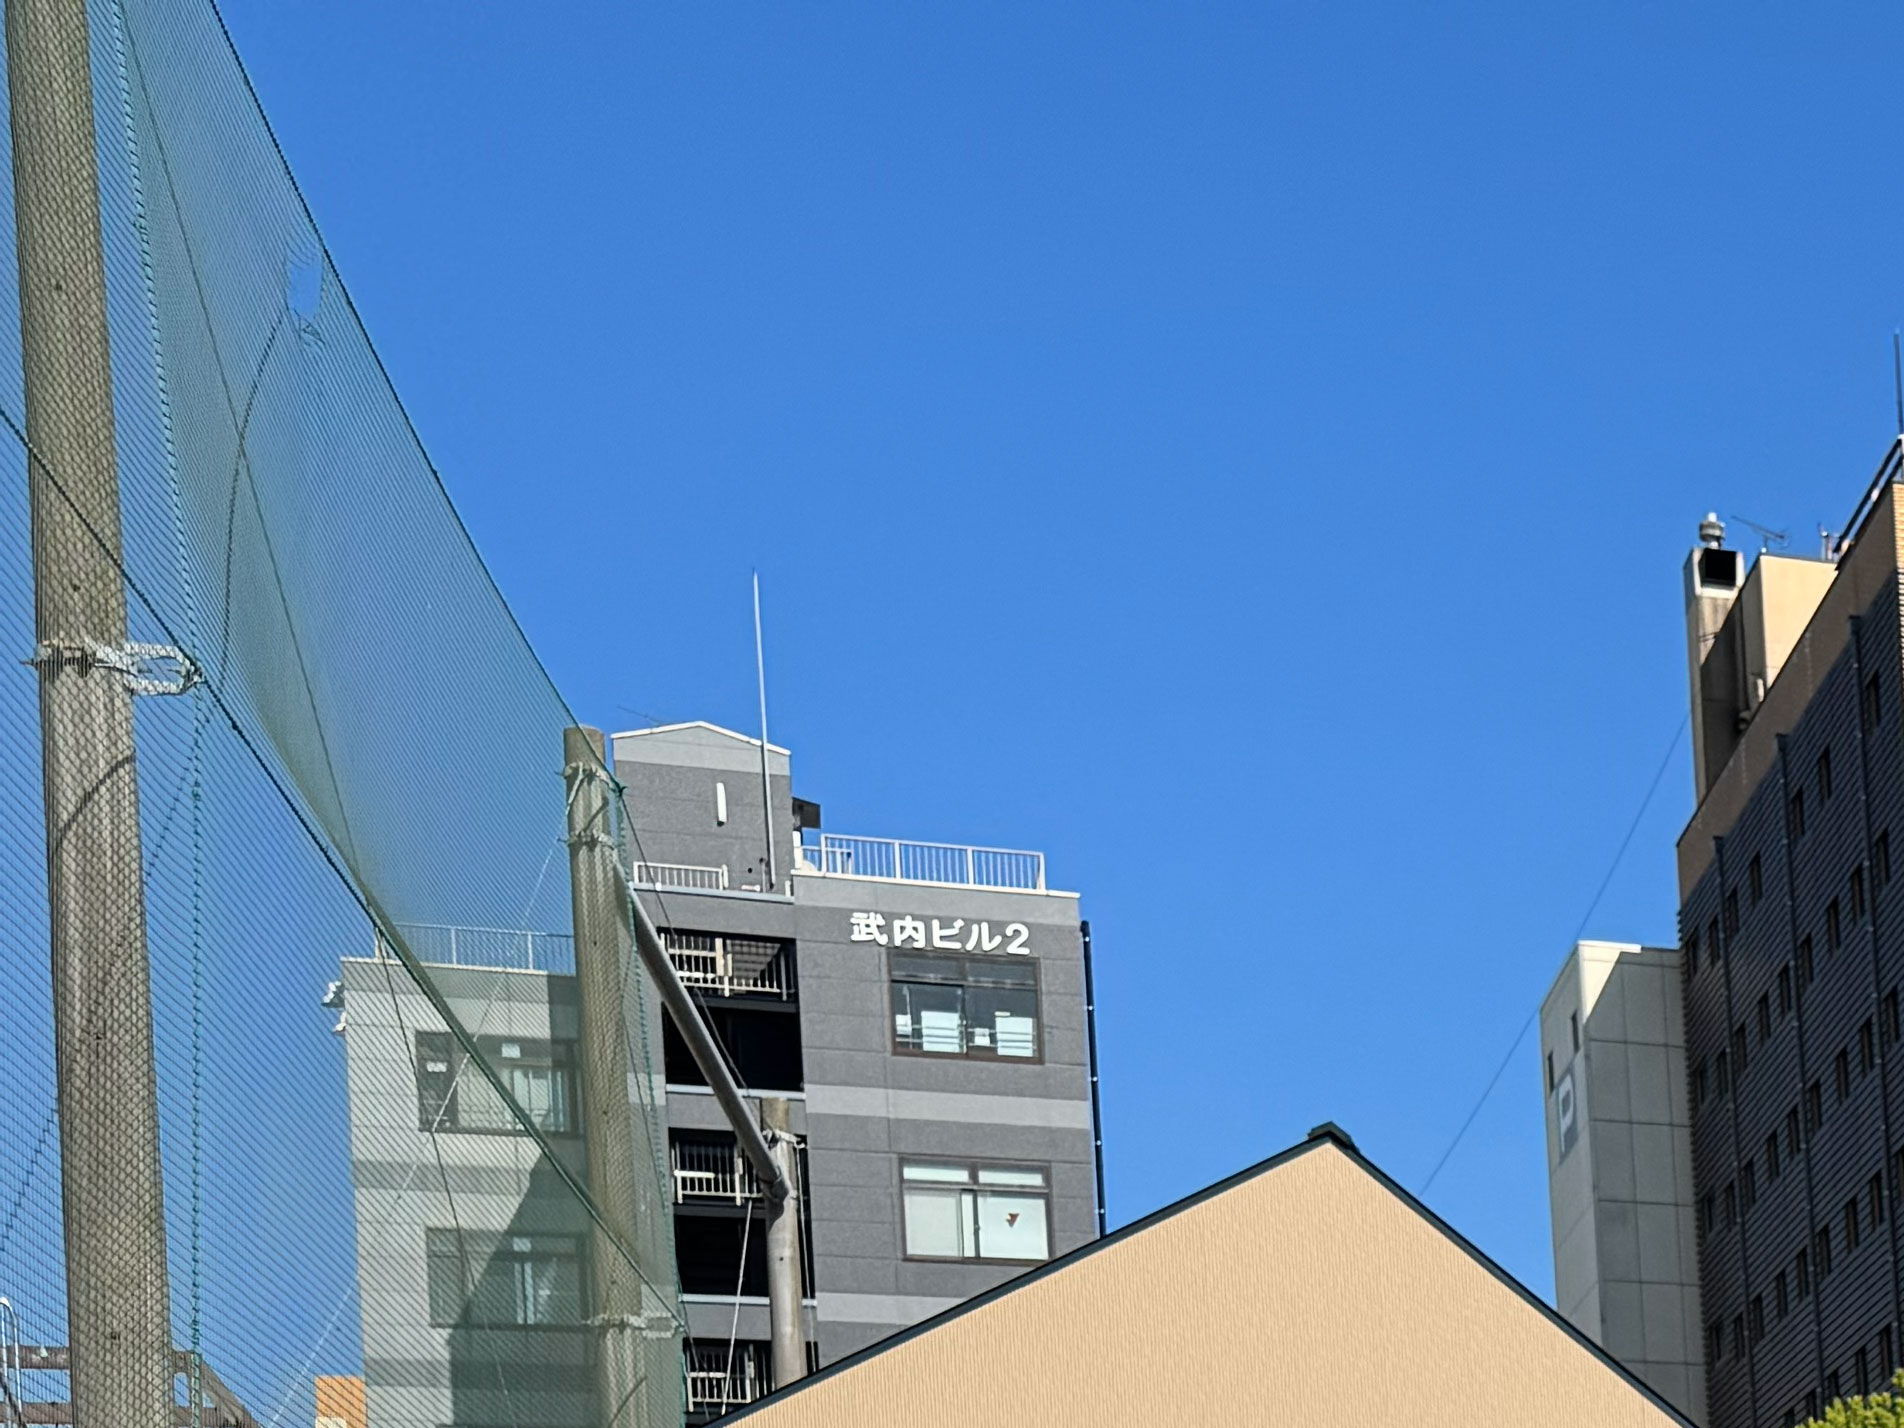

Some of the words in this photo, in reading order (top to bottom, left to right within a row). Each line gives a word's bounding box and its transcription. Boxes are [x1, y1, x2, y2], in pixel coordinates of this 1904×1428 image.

[850, 911, 1030, 955] 武内ビル2
[1559, 1074, 1574, 1153] P
